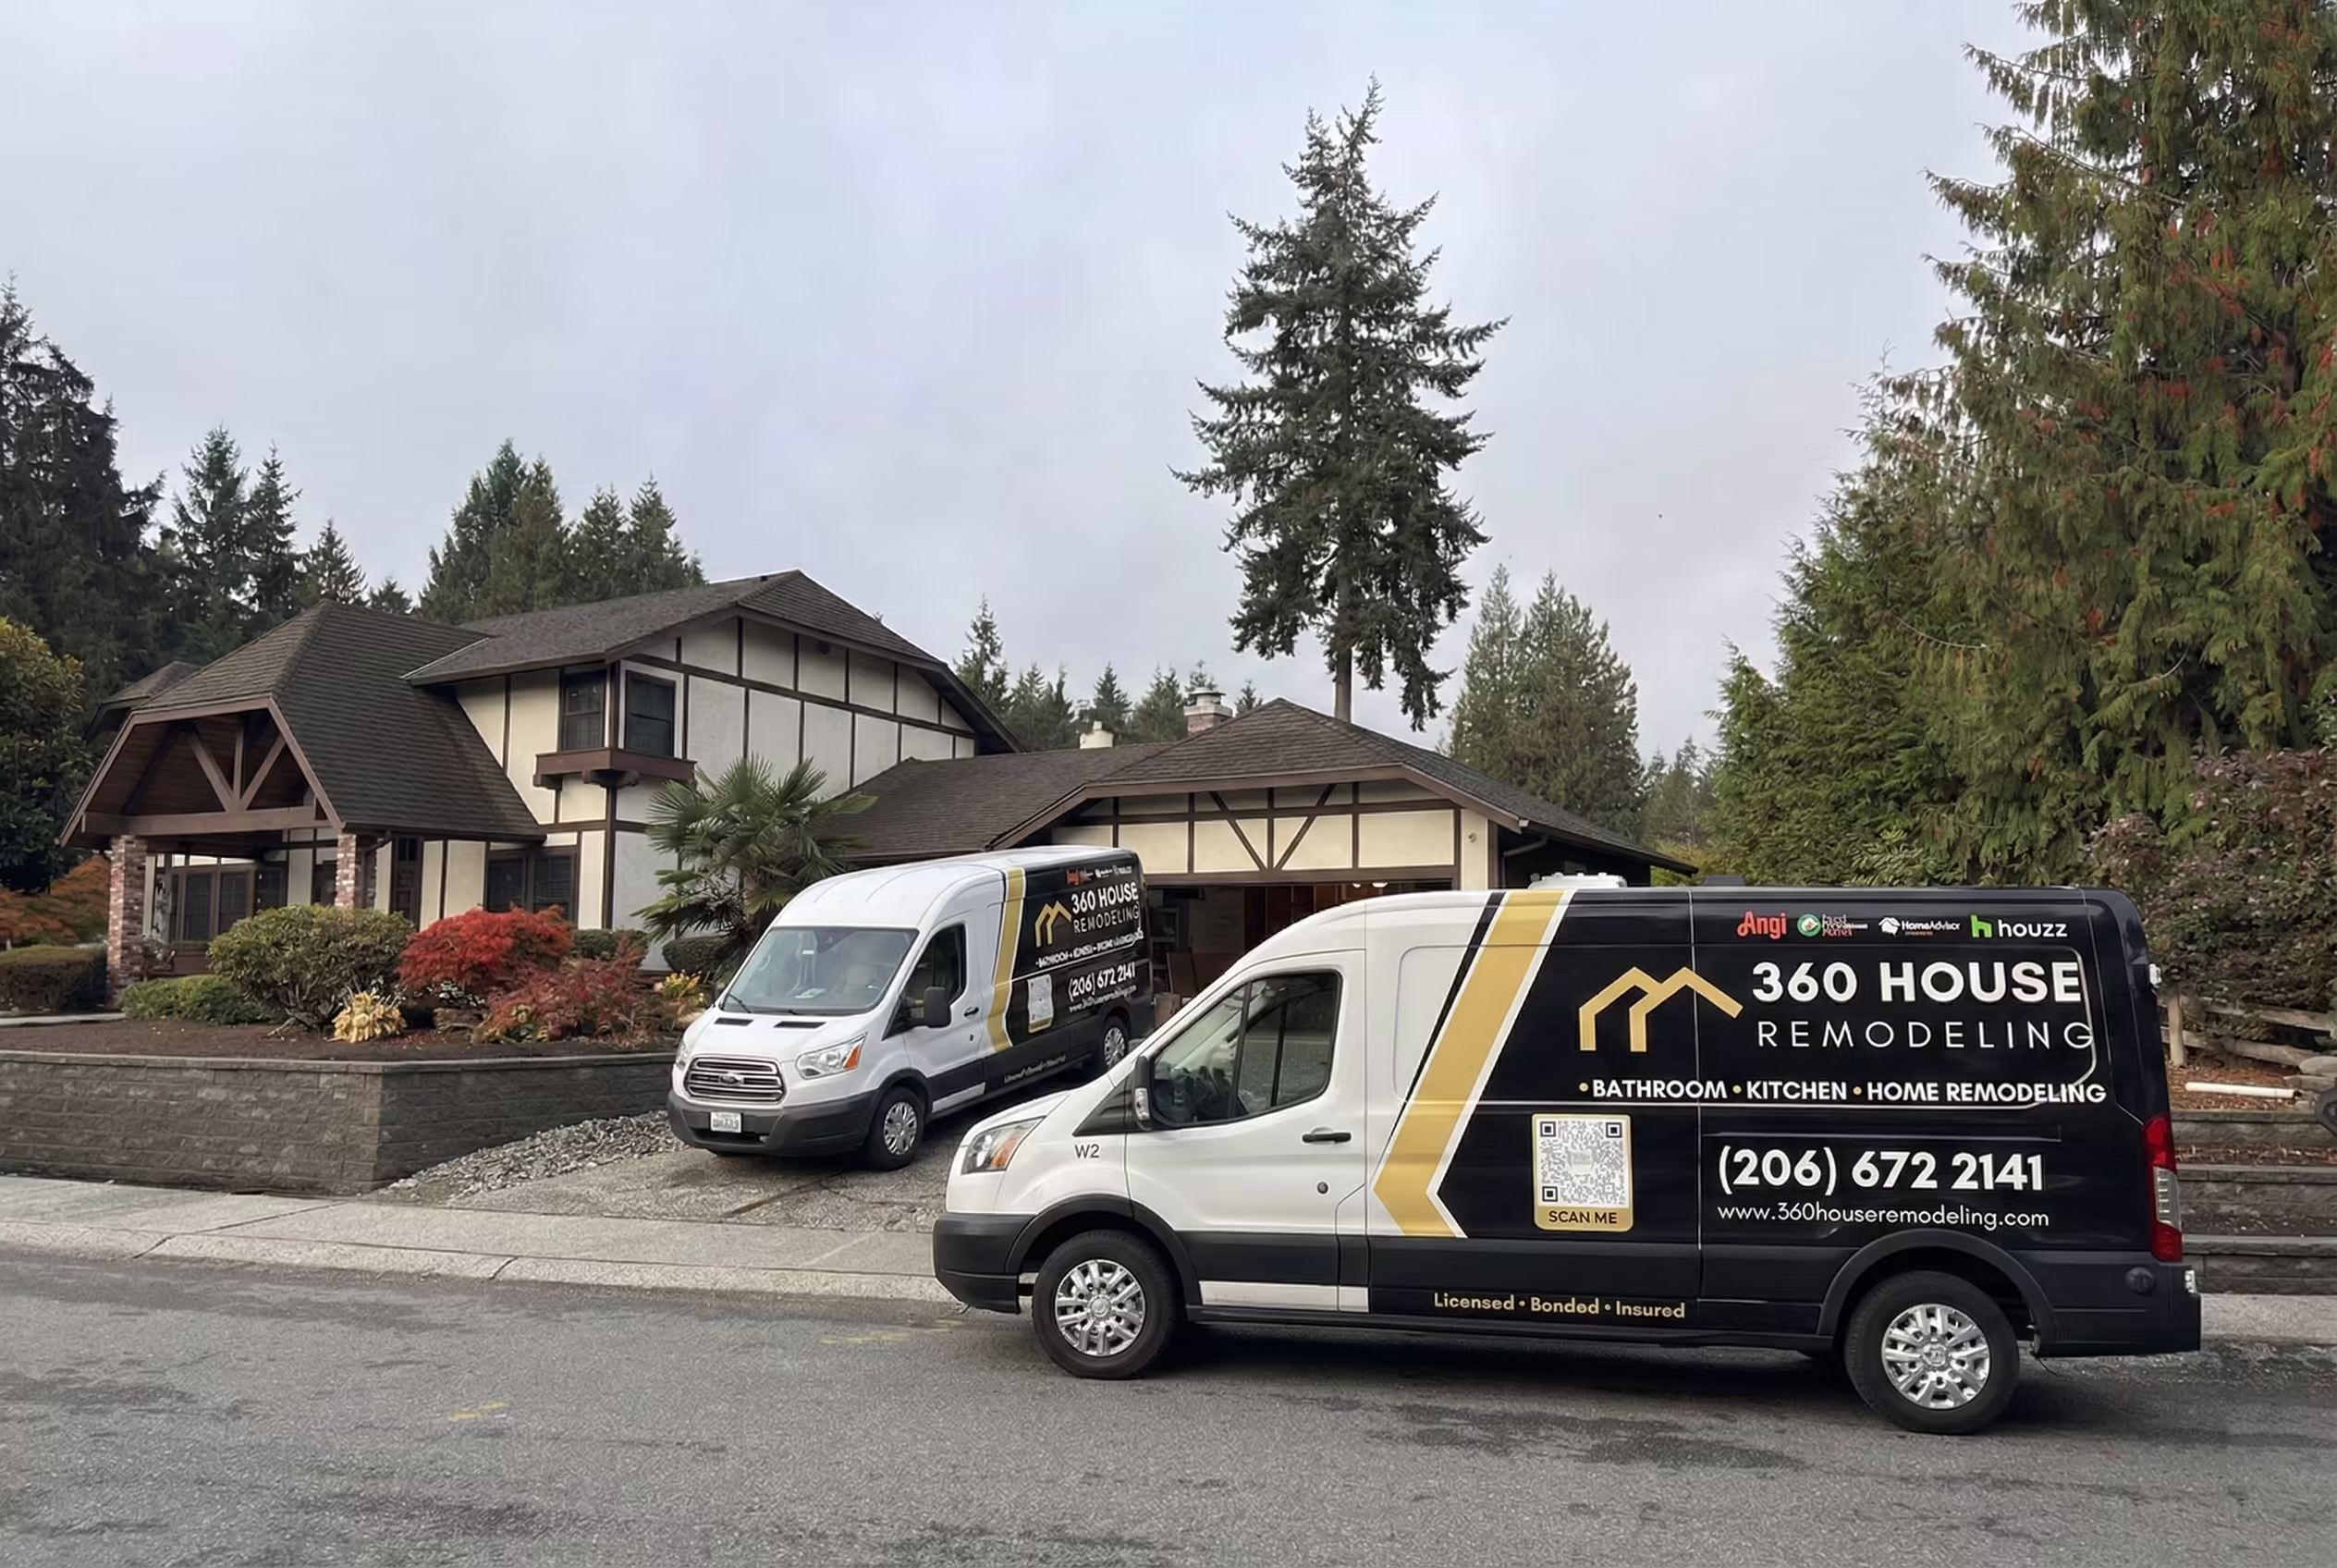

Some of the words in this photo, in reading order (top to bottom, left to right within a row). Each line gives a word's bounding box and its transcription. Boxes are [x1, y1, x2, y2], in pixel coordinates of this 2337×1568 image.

[1071, 893, 1096, 913] 360
[1097, 881, 1139, 908] HOUSE
[1073, 904, 1140, 934] REMODELING
[1737, 911, 1787, 939] Angi
[1998, 919, 2068, 937] houzz
[1068, 972, 1095, 1003] (206)
[1096, 967, 1117, 988] 672
[1117, 962, 1135, 983] 2141
[1752, 962, 1857, 1002] 360
[1879, 962, 2081, 1002] HOUSE
[1757, 1021, 2093, 1048] REMODELING
[1593, 1079, 1727, 1099] BATHROOM
[1746, 1081, 1847, 1100] KITCHEN
[1867, 1082, 1939, 1102] HOME
[1946, 1083, 2107, 1104] REMODELING
[1074, 1144, 1100, 1158] W2
[1719, 1145, 1837, 1196] (206)
[1852, 1150, 1938, 1189] 672
[1951, 1152, 2042, 1191] 2141
[1548, 1210, 1590, 1223] SCAN
[1595, 1212, 1618, 1224] ME
[1718, 1201, 2049, 1231] www.360houseremodeling.com
[1434, 1292, 1514, 1310] Licensed
[1531, 1297, 1599, 1315] Bonded
[1616, 1300, 1685, 1318] Insured
